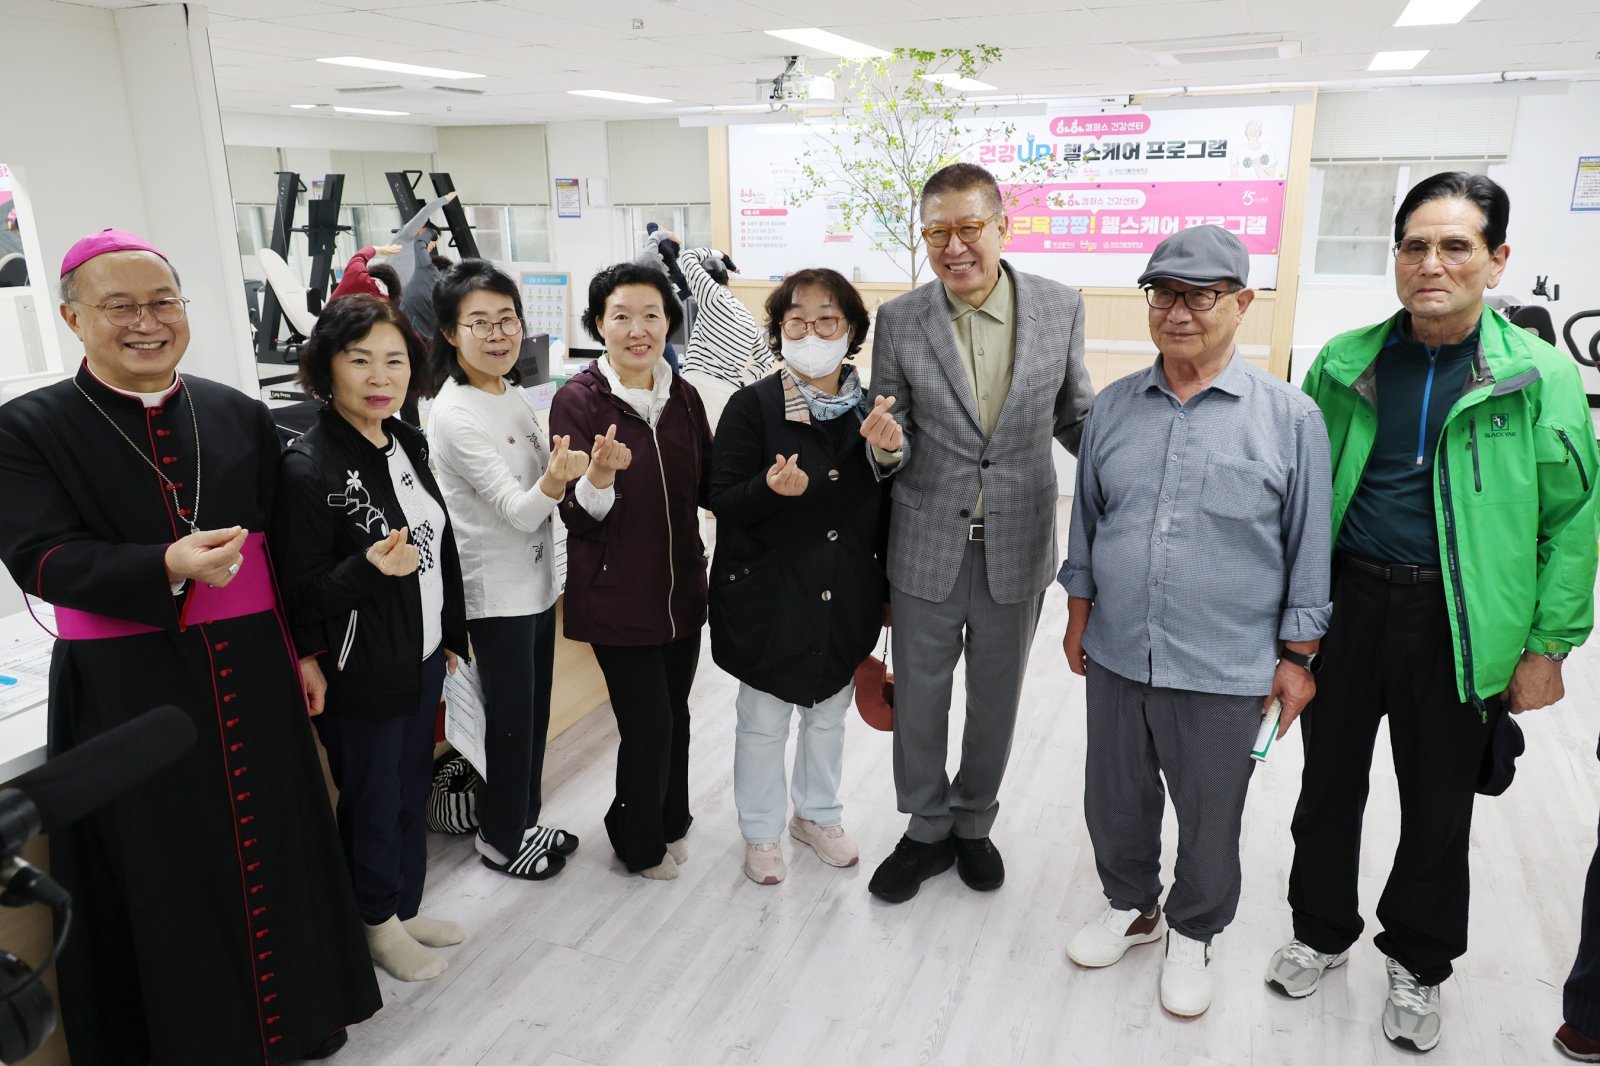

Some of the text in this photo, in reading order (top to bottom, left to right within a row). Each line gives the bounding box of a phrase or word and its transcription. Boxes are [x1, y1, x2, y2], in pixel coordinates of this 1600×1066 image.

[1111, 121, 1144, 132] 건강센터
[1063, 140, 1141, 162] 헬스케어
[1146, 139, 1228, 160] 프로그램
[1107, 197, 1139, 206] 건강센터
[1012, 215, 1097, 235] 근육짱짱!
[1101, 215, 1180, 235] 헬스케어
